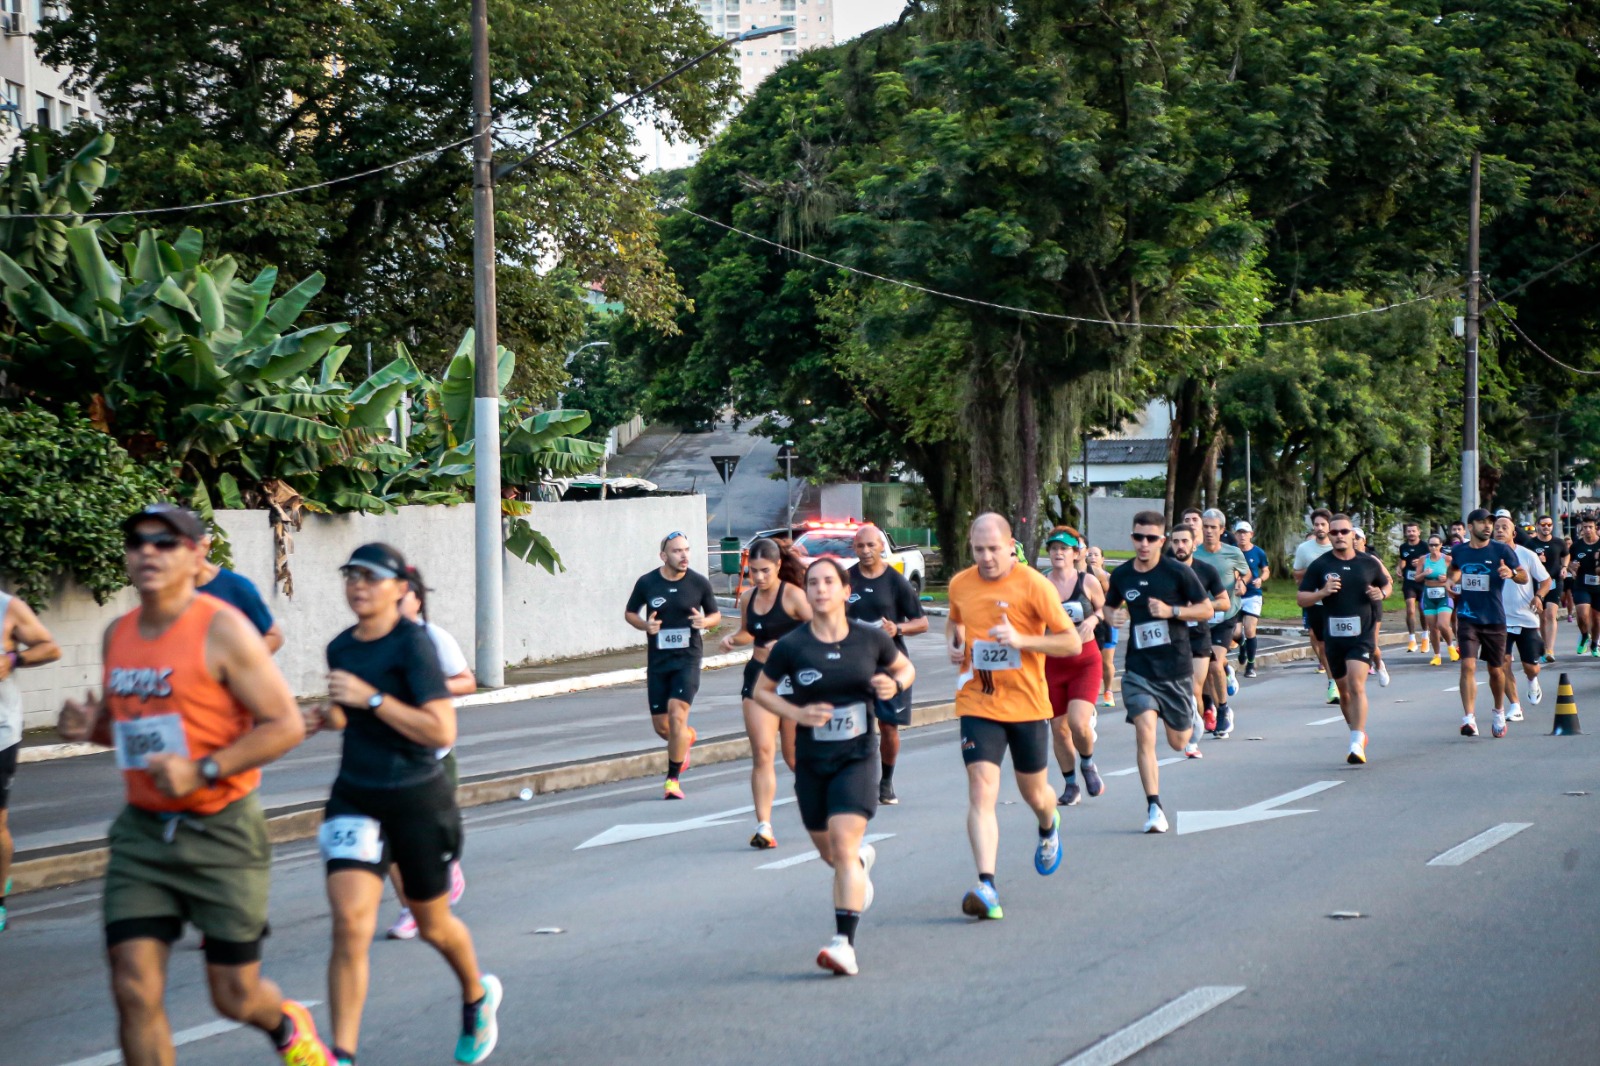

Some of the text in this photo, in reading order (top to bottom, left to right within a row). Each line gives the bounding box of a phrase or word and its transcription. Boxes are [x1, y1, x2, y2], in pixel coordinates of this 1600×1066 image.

[1466, 578, 1482, 587] 361
[1335, 622, 1353, 632] 196
[665, 634, 683, 643] 489
[1142, 628, 1162, 641] 516
[982, 649, 1008, 662] 322
[827, 716, 854, 732] 175
[329, 829, 357, 847] 55
